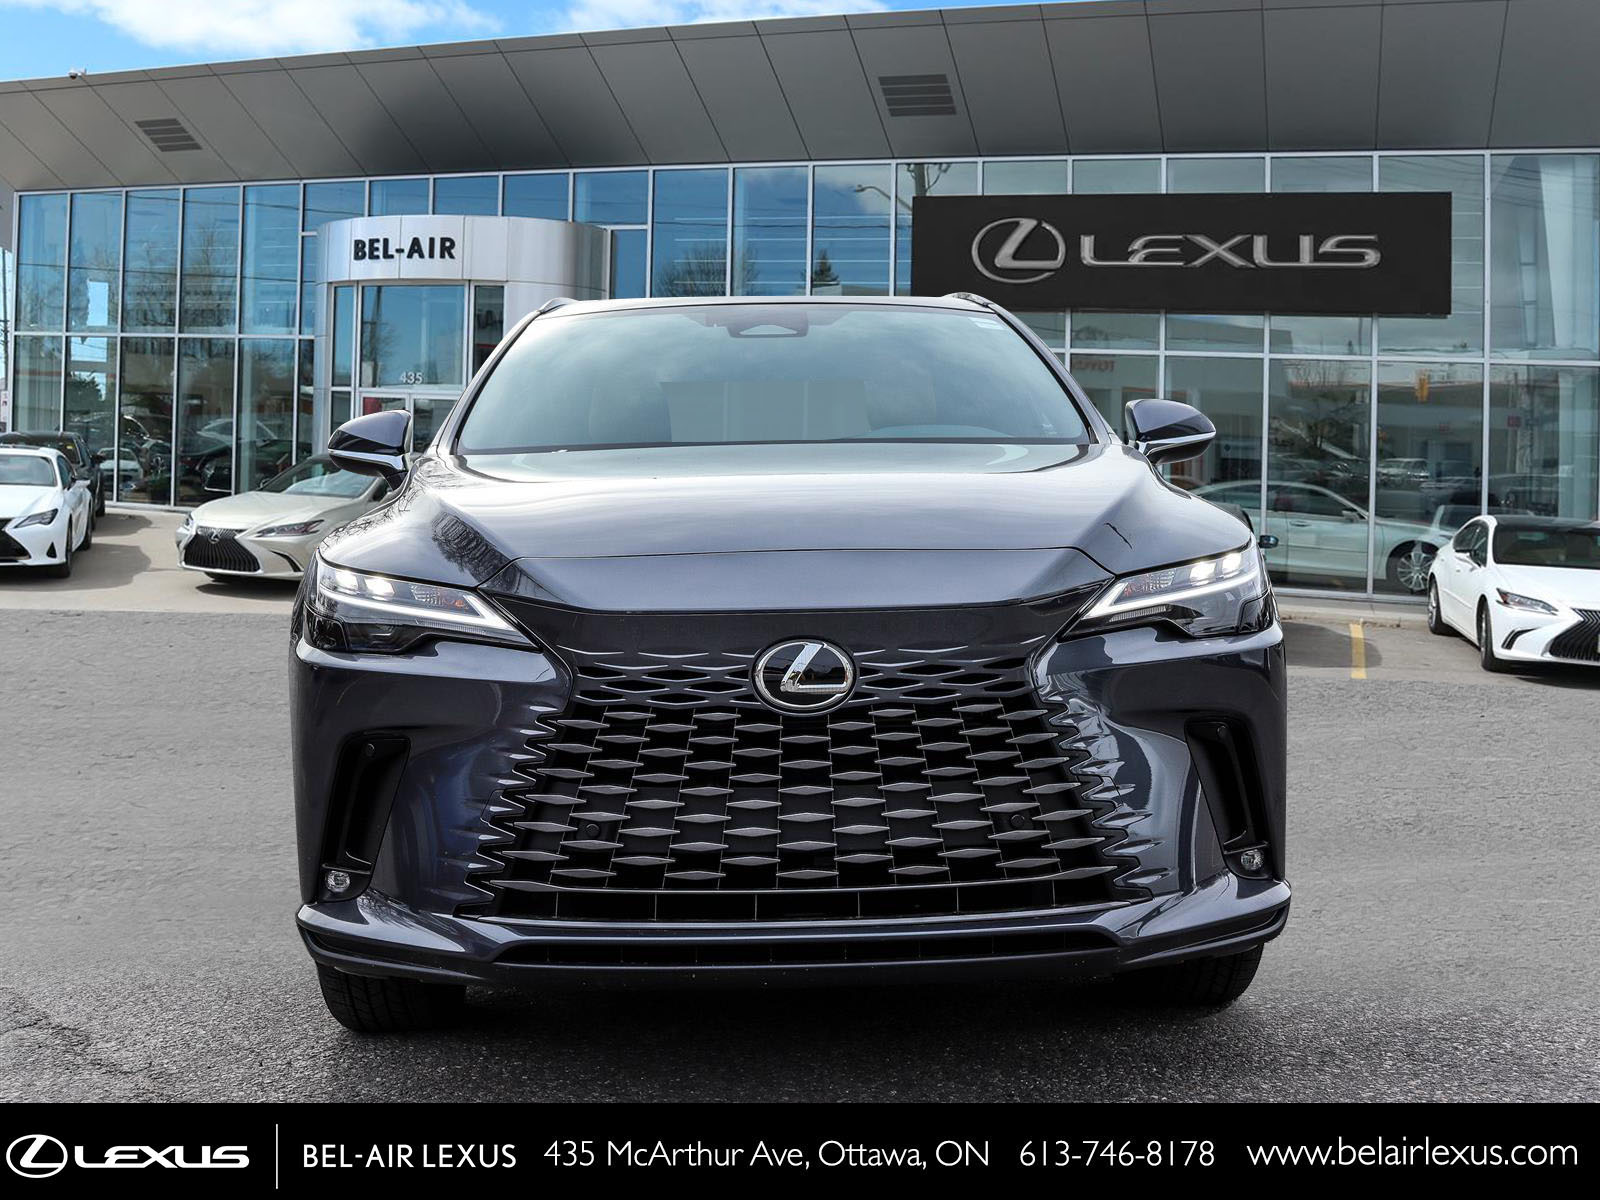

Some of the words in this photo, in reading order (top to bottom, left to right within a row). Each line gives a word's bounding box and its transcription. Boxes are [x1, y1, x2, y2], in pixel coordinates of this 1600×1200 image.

[353, 237, 457, 261] BEL-AIR
[1079, 234, 1382, 269] LEXUS
[399, 371, 423, 385] 435
